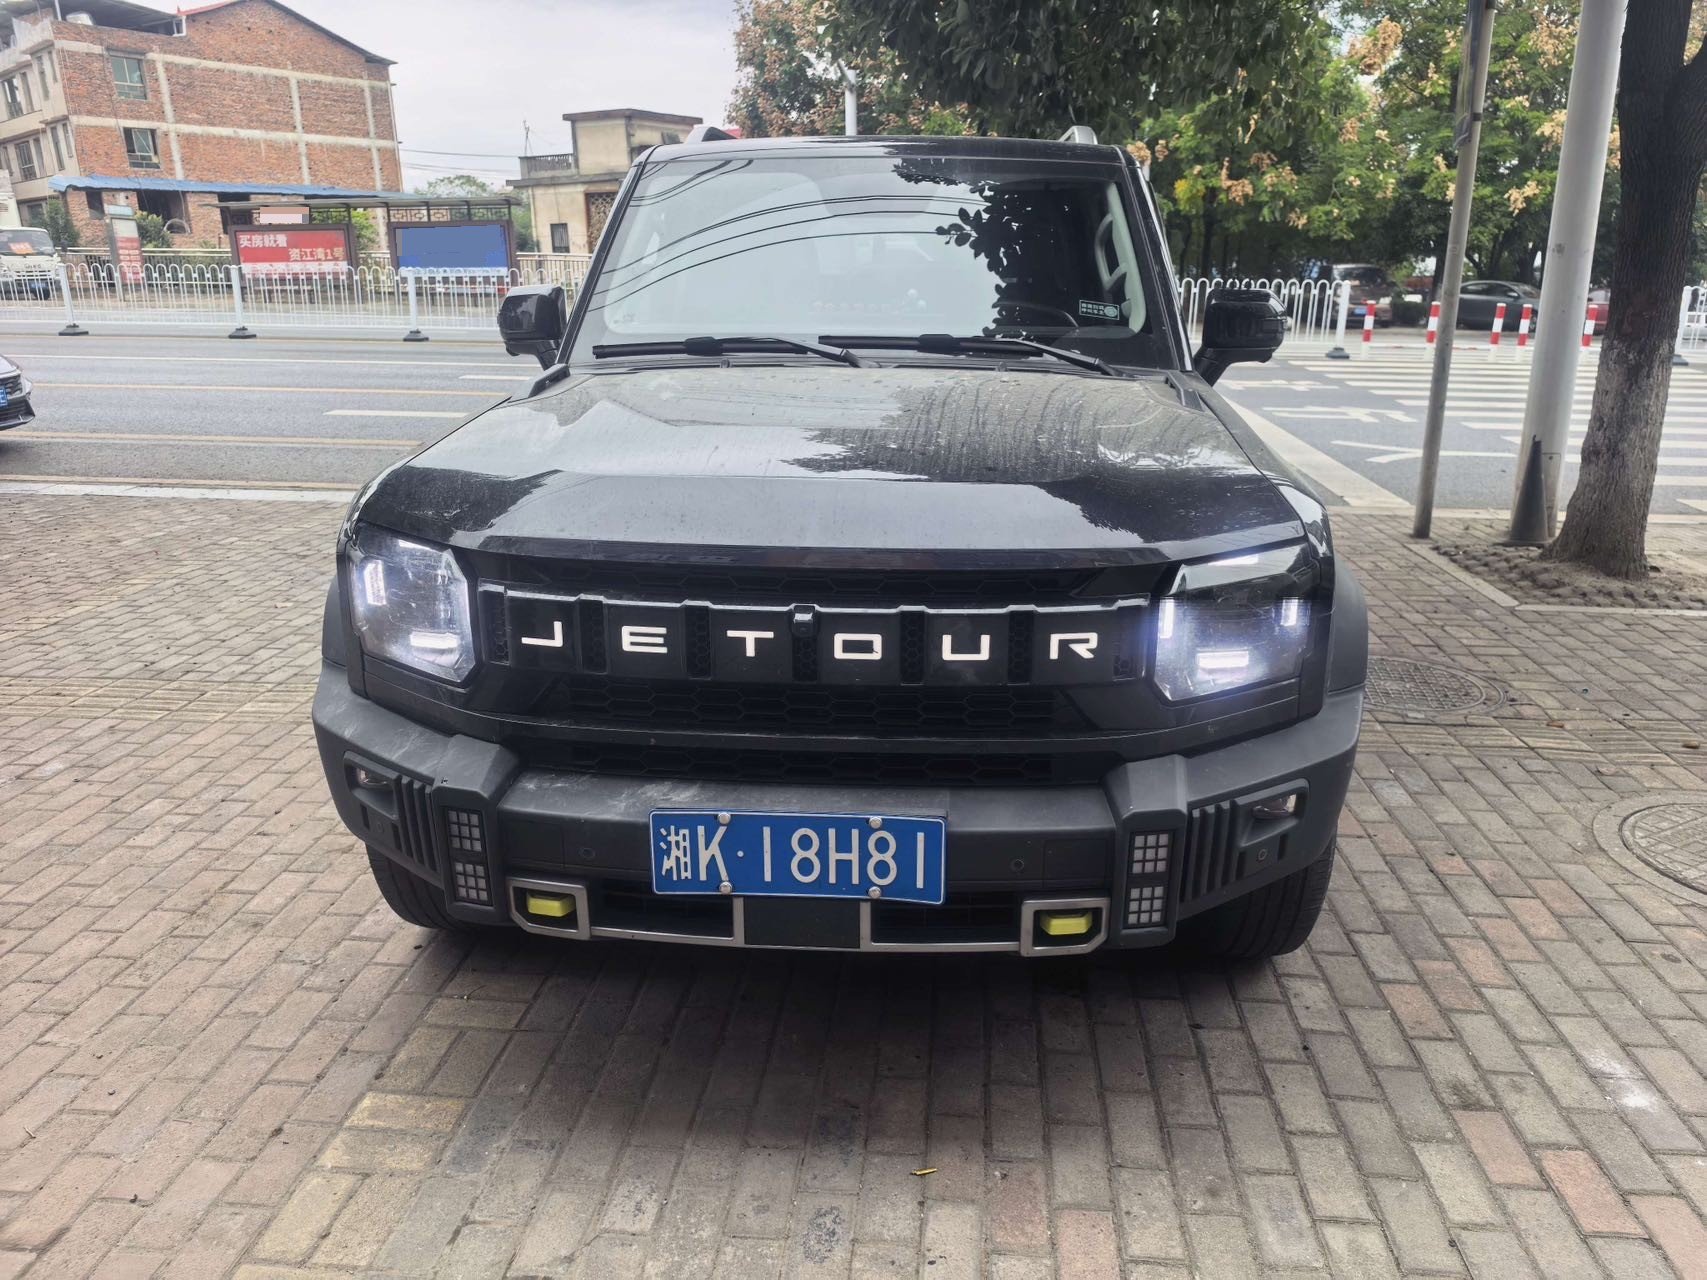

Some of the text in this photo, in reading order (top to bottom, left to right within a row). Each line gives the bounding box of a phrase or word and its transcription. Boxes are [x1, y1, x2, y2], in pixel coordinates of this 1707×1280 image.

[239, 234, 287, 247] 买房就看
[521, 621, 1099, 660] JETOUR
